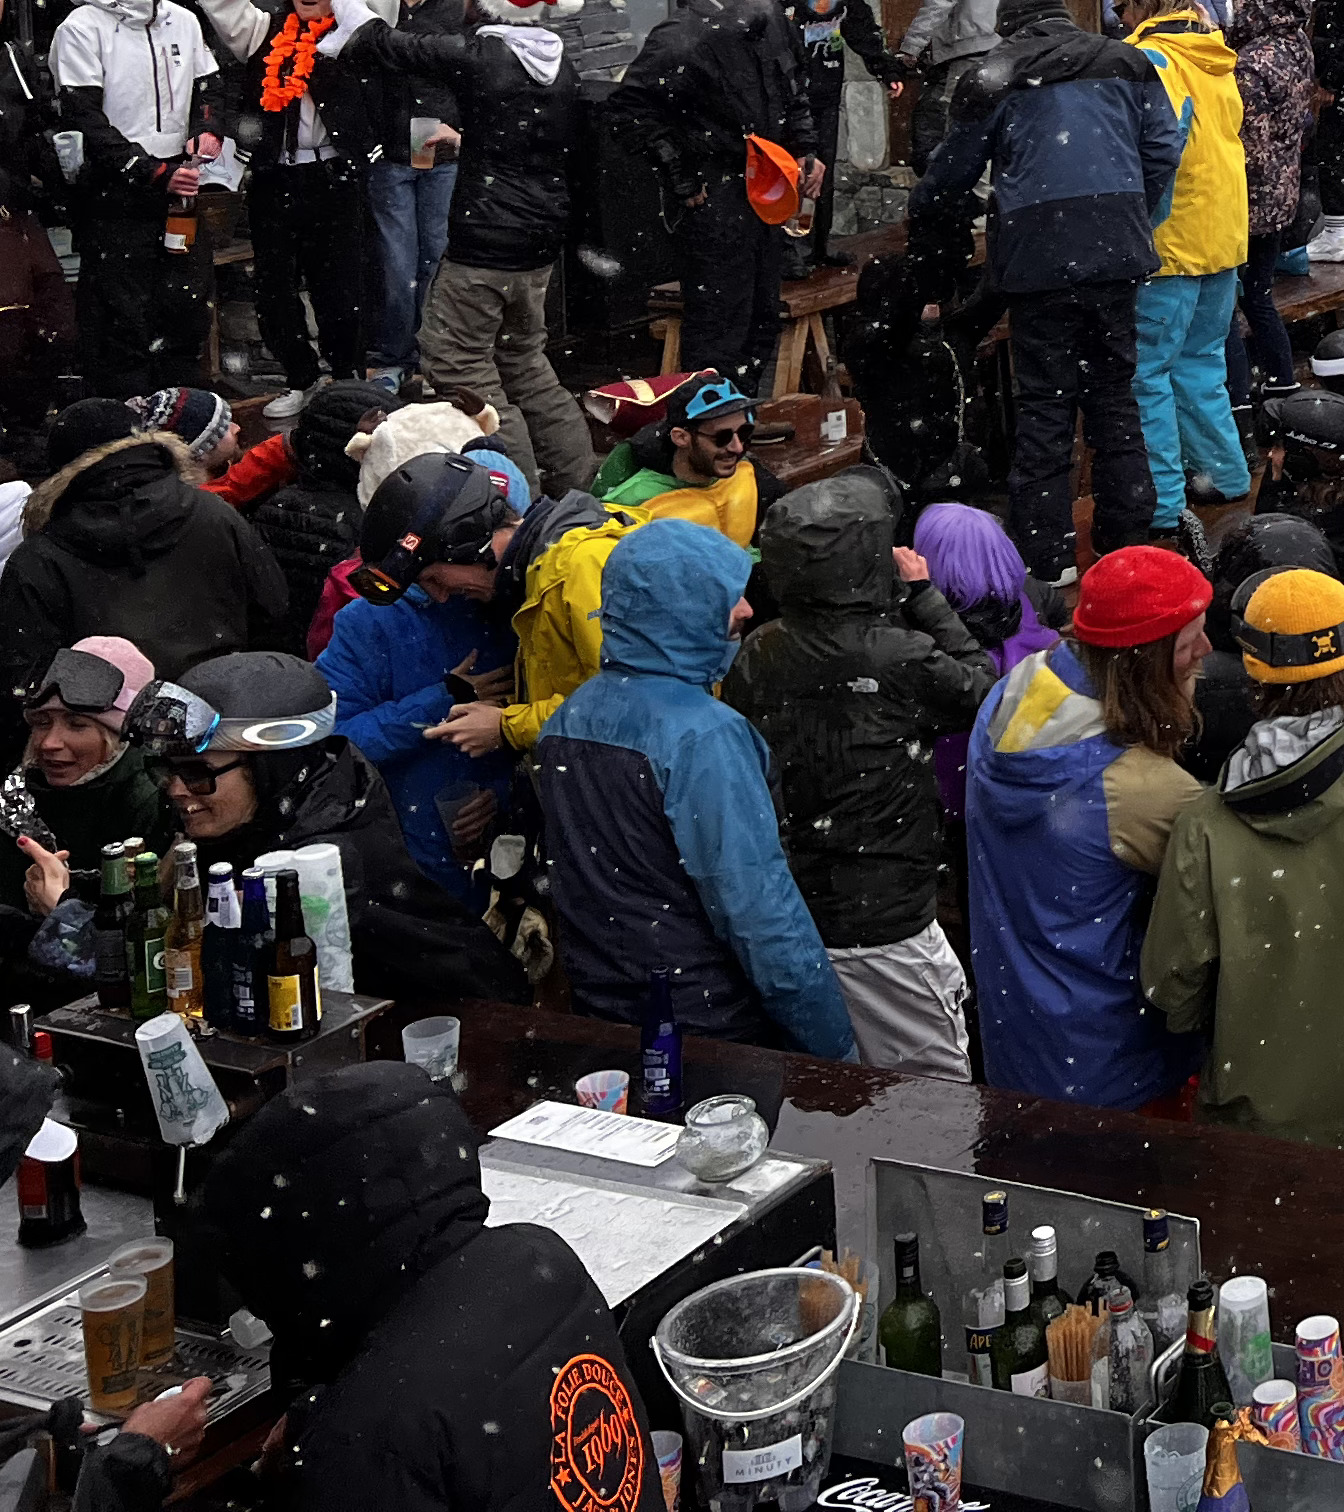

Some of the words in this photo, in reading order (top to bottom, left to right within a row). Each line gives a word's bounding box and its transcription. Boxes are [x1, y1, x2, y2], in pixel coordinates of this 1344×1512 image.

[969, 1333, 993, 1350] APE
[555, 1367, 583, 1421] FOLIE
[581, 1363, 625, 1407] DOUCE
[554, 1431, 567, 1464] LA
[581, 1407, 622, 1481] 1969
[734, 1455, 793, 1477] MINUTY
